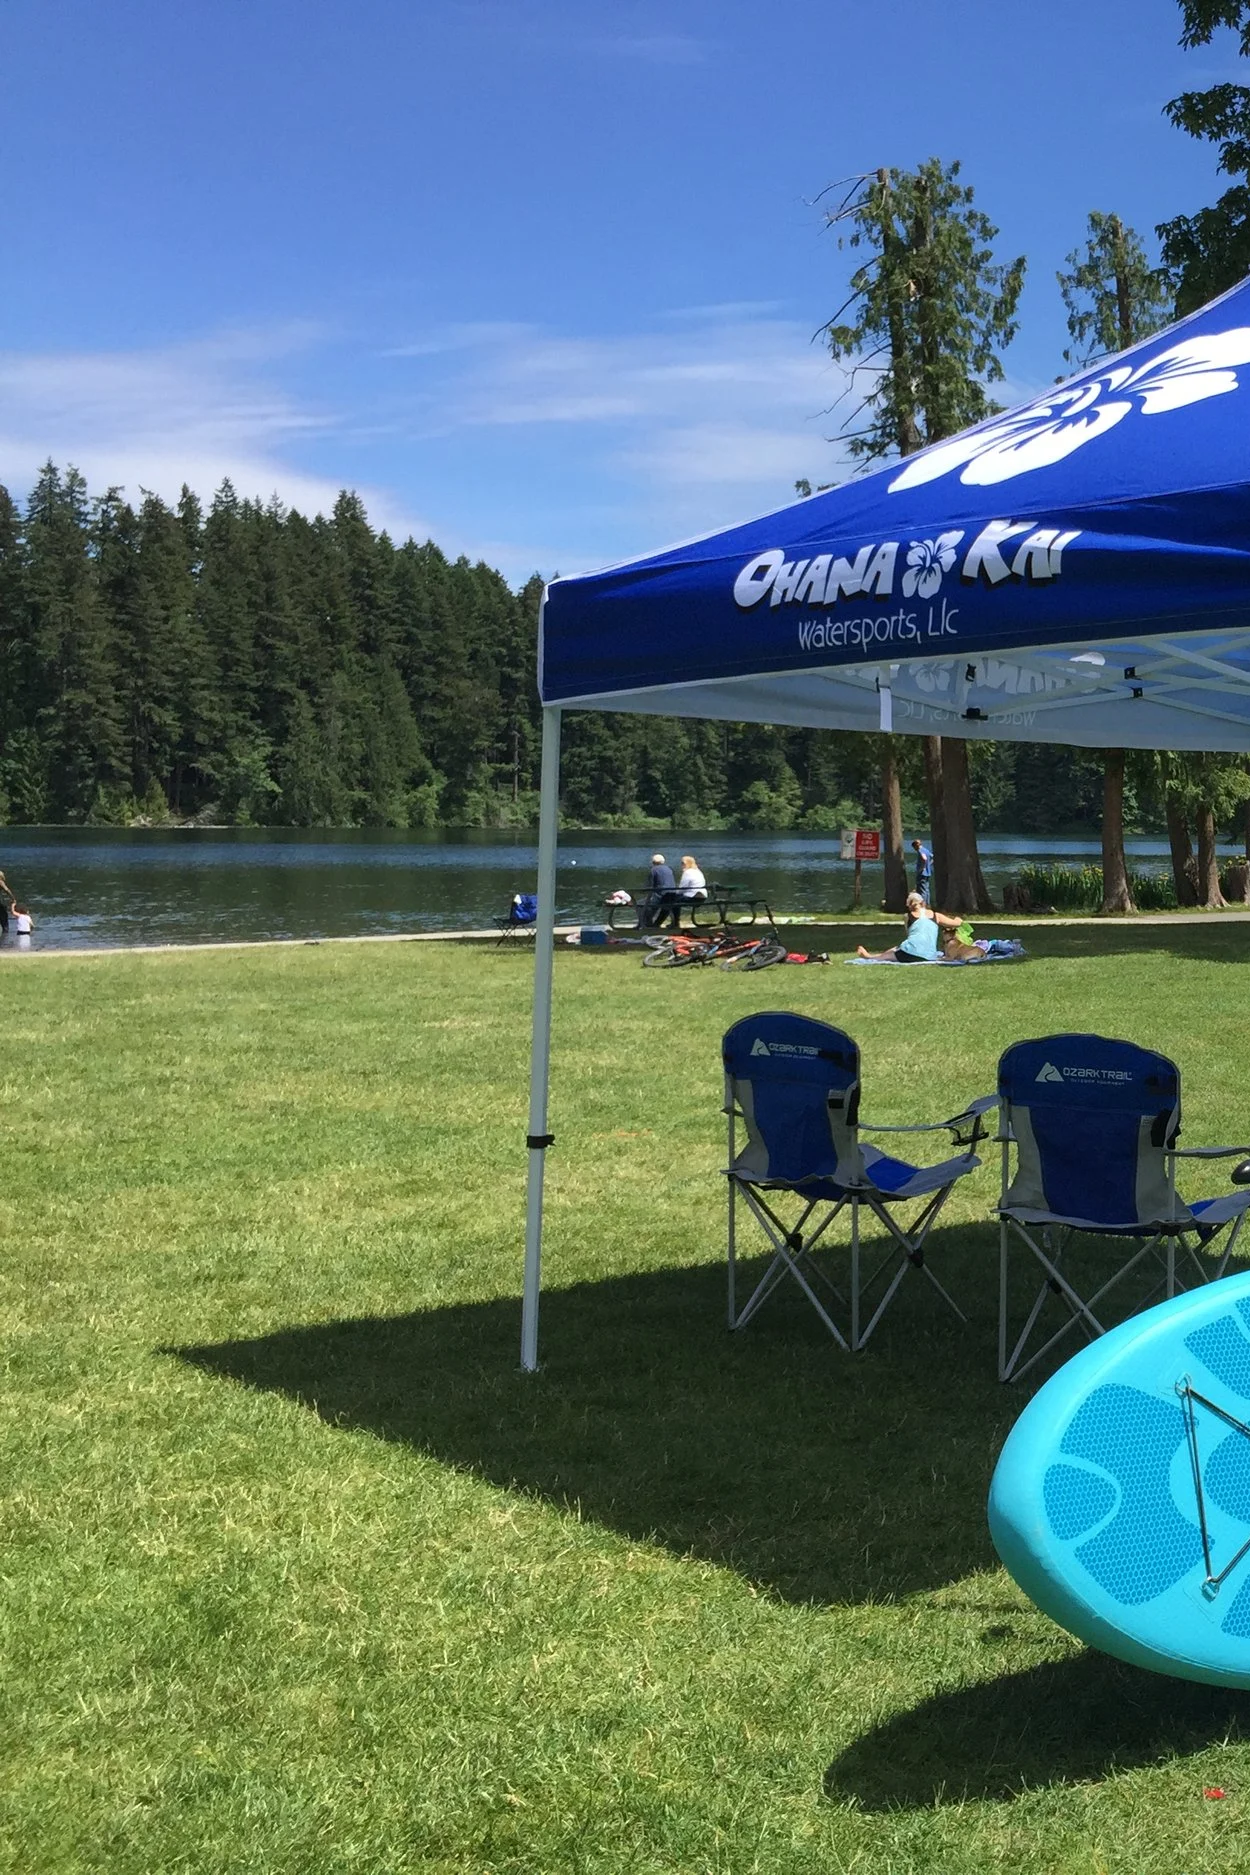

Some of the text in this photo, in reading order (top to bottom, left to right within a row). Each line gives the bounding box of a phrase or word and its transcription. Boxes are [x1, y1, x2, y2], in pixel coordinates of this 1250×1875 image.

[733, 542, 899, 607] OHANA
[799, 598, 959, 653] Watersports, Llc
